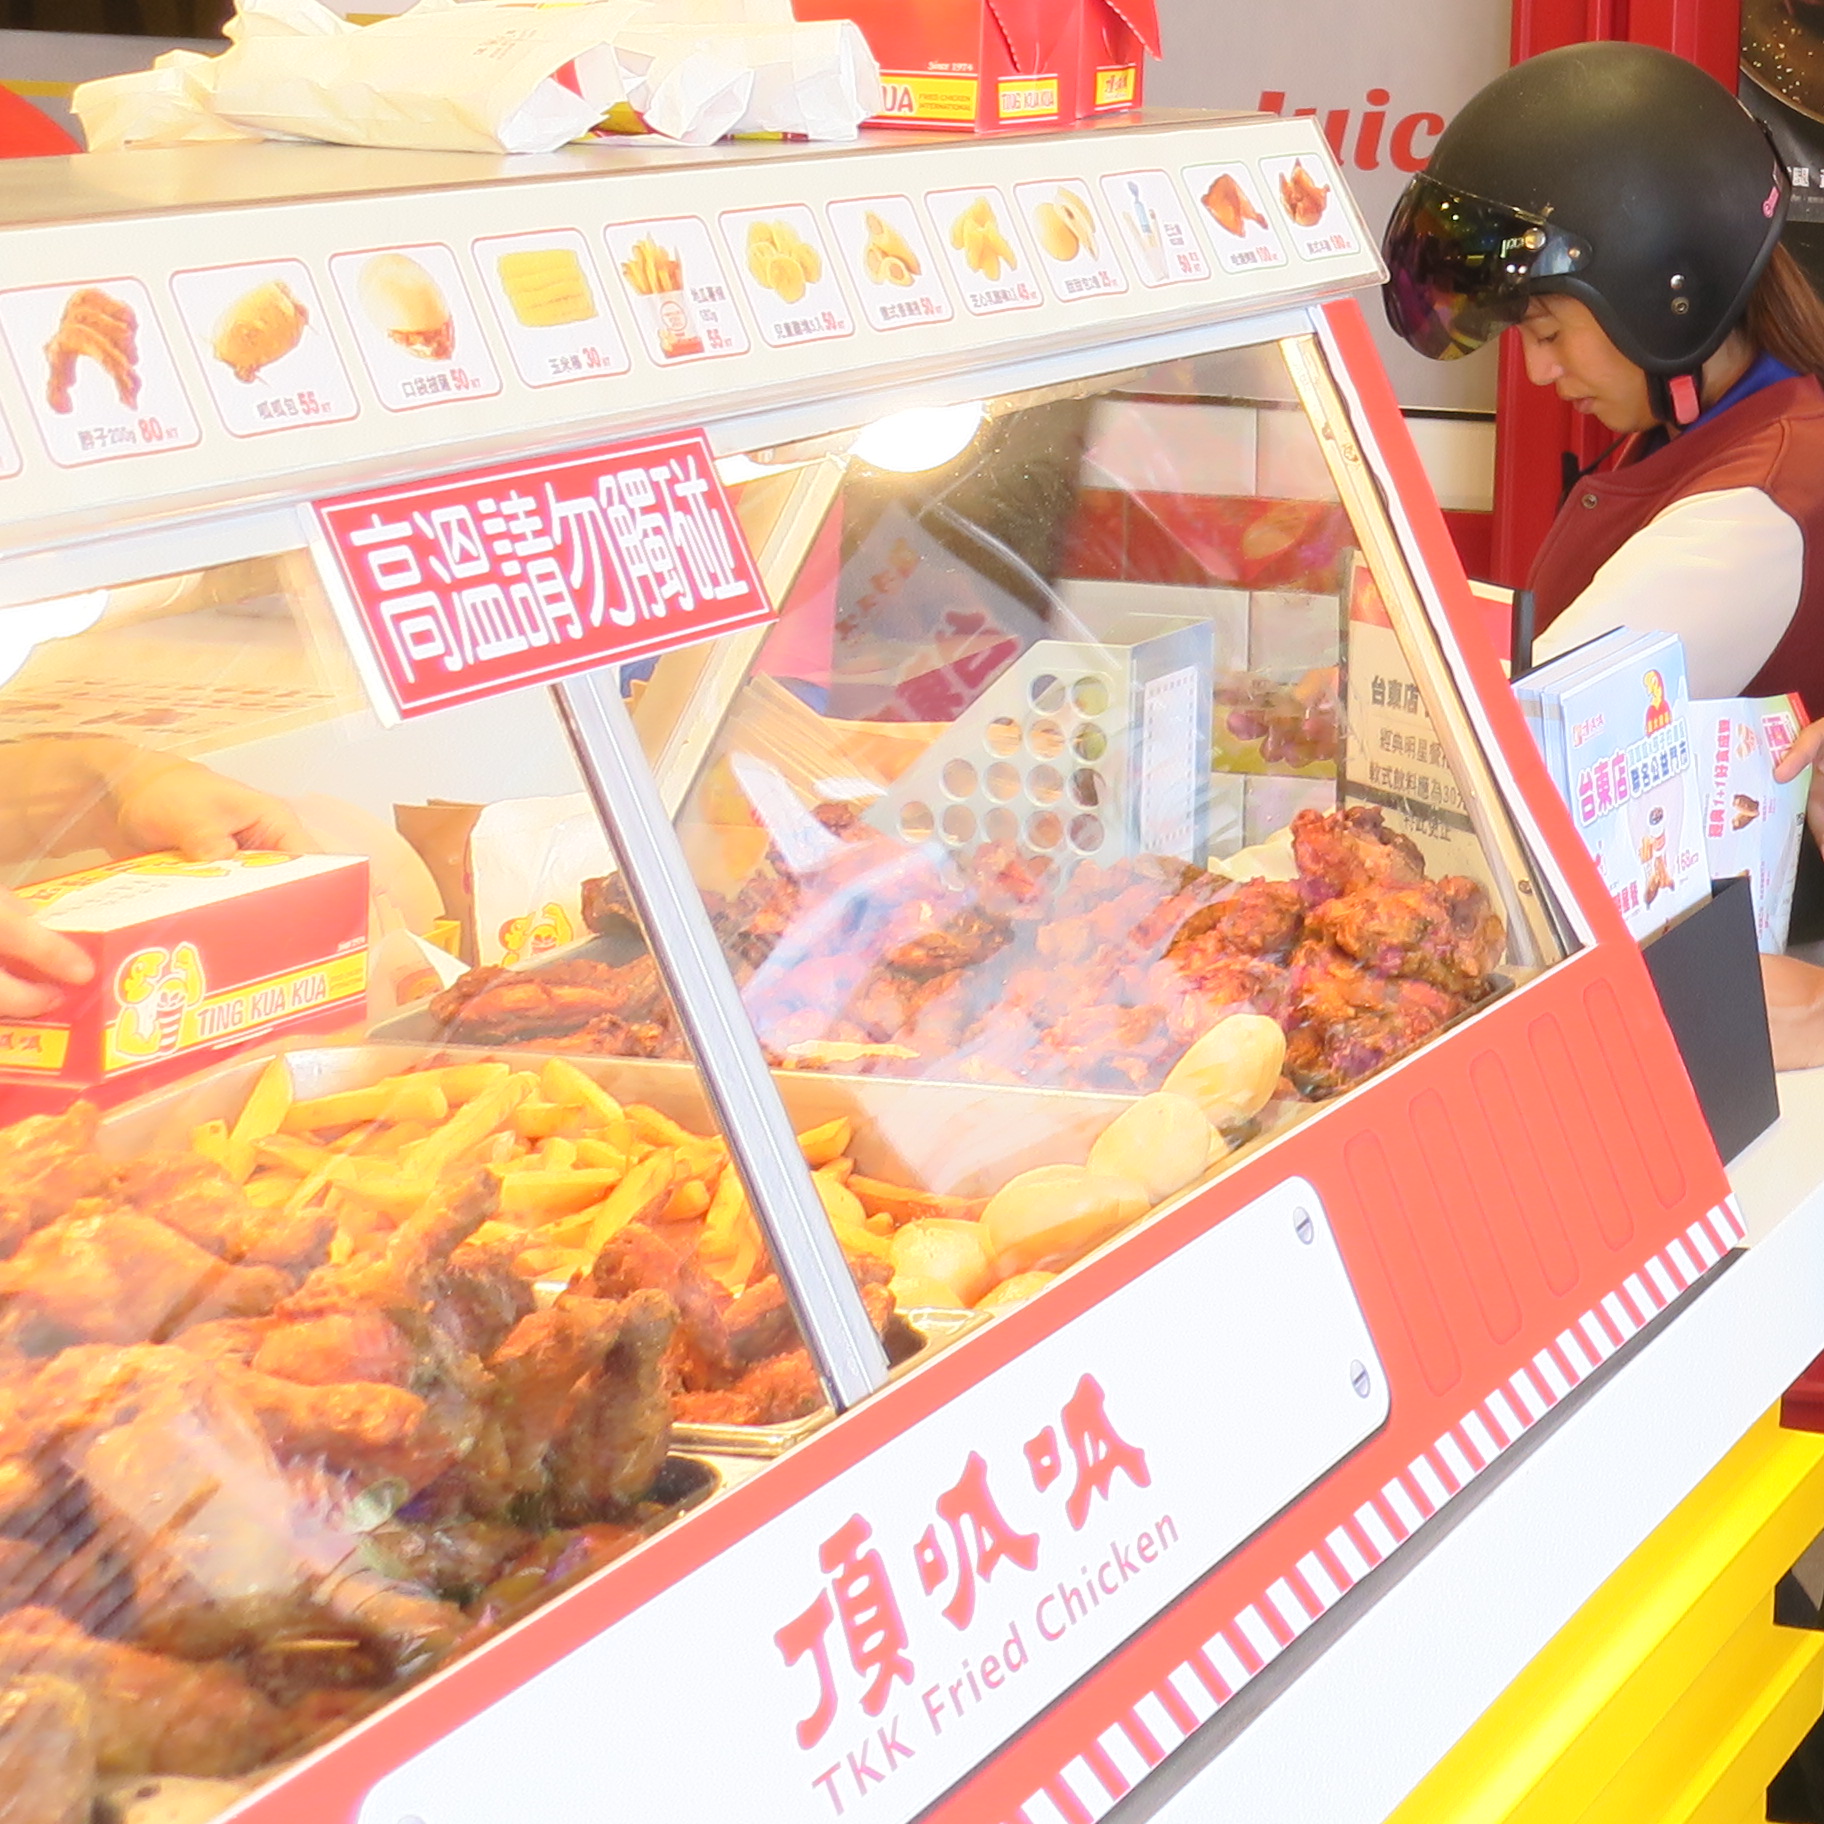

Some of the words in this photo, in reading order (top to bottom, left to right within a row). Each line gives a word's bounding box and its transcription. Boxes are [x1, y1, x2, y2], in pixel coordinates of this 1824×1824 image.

[881, 85, 914, 114] UA
[139, 417, 163, 443] 80
[349, 454, 750, 684] 高溫請勿觸碰
[1579, 752, 1628, 824] 台東店
[197, 1000, 244, 1037] TING
[250, 986, 287, 1021] KUA
[292, 974, 328, 1008] KUA
[774, 1372, 1152, 1751] 頂呱呱
[811, 1714, 917, 1817] TKK
[921, 1621, 1030, 1736] Fried
[1034, 1512, 1180, 1643] Chicken
